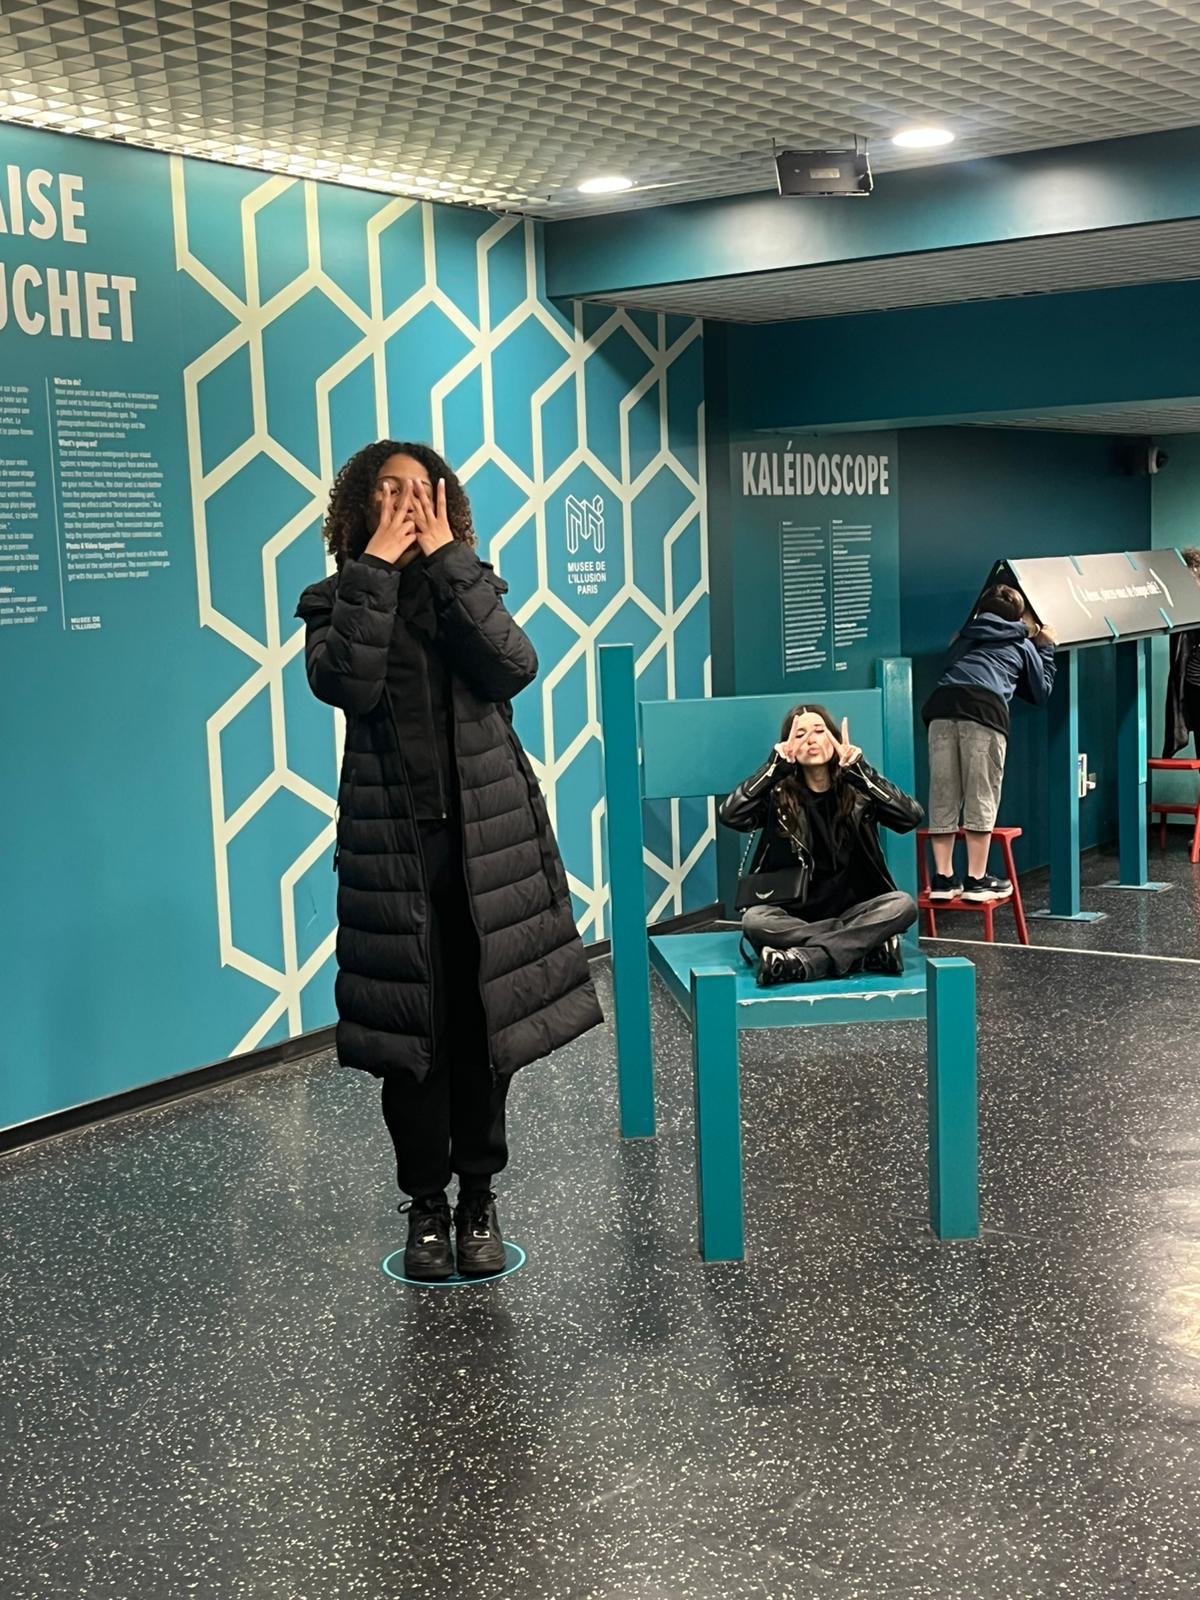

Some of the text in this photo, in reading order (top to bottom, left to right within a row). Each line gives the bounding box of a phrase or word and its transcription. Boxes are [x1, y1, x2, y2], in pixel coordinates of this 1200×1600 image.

[742, 440, 890, 496] KALÉIDOSCOPE
[567, 561, 606, 572] MUSEE DE
[568, 573, 607, 584] L'ILLUSION
[577, 584, 598, 595] PARIS
